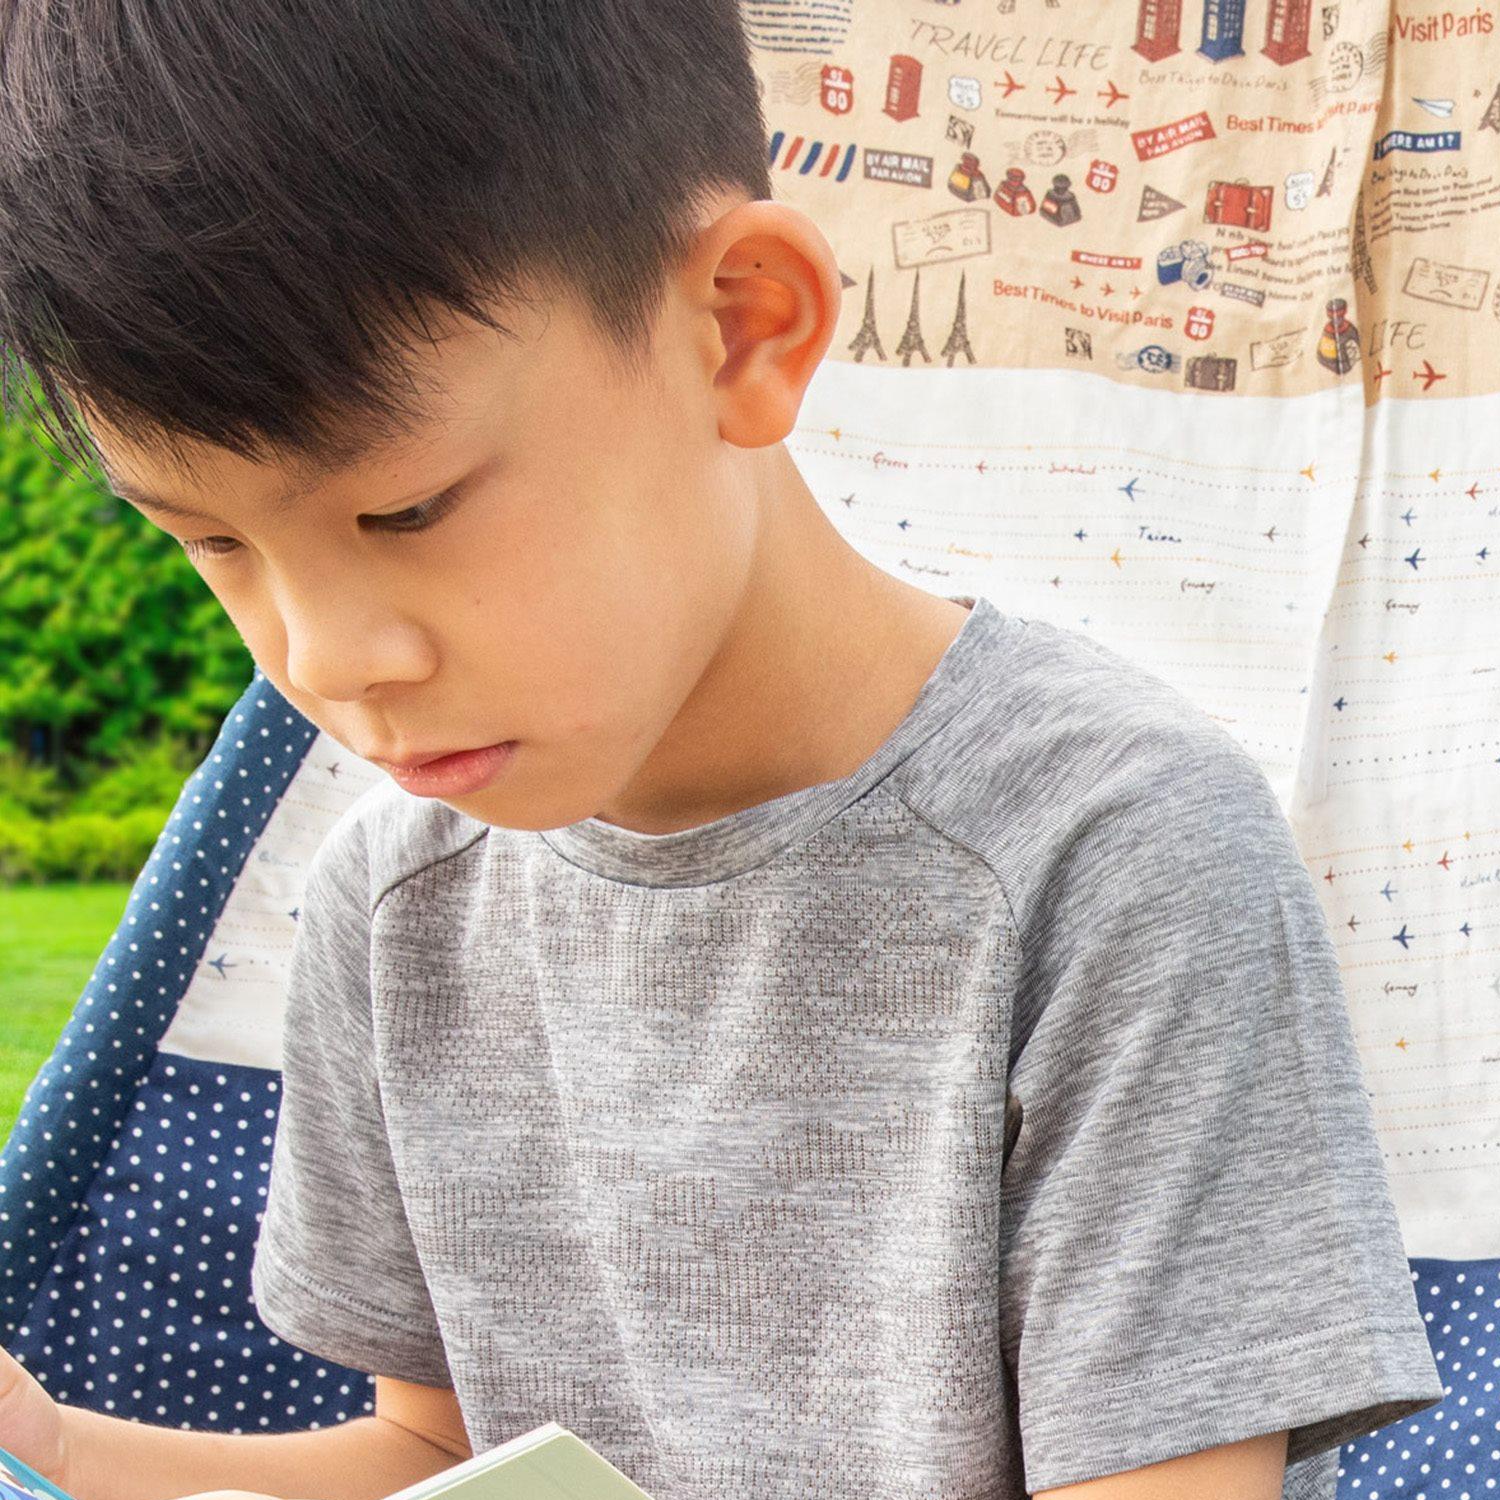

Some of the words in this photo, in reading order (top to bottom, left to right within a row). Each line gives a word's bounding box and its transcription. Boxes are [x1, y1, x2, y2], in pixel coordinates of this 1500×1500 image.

[1395, 14, 1439, 42] Visit
[1443, 8, 1494, 38] Paris
[911, 18, 1027, 64] TRAVEL
[1036, 36, 1113, 71] LIFE
[1226, 115, 1263, 132] Best
[1267, 115, 1314, 134] Times
[1417, 138, 1436, 148] AM
[865, 153, 881, 166] BY
[902, 156, 930, 173] MAIL
[891, 169, 922, 183] AVION
[993, 279, 1028, 298] Best
[1032, 287, 1076, 312] Times
[1080, 303, 1095, 317] to
[1097, 305, 1130, 325] Visit
[1131, 311, 1174, 330] Paris
